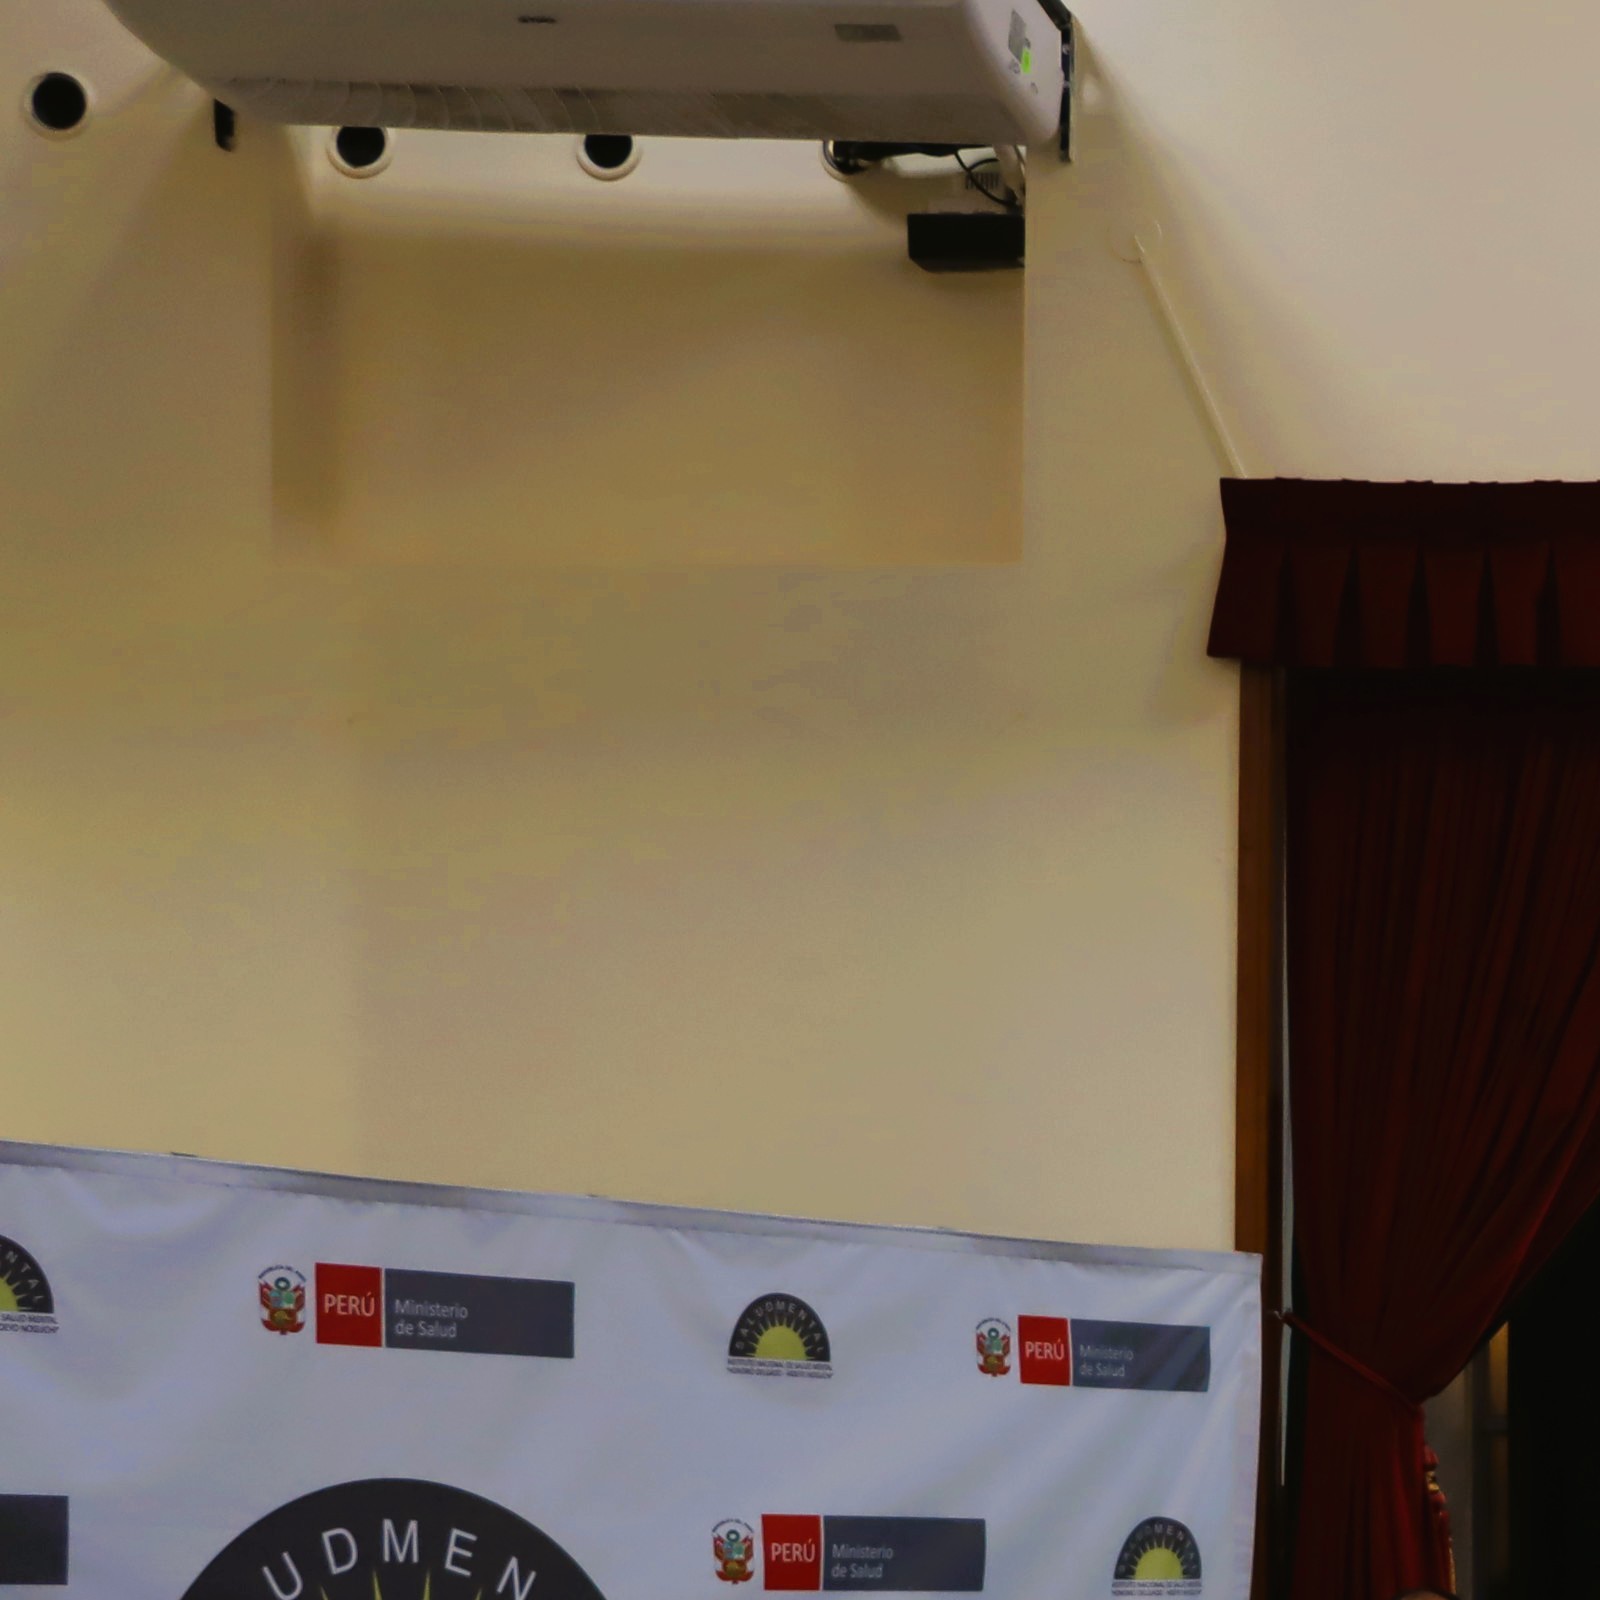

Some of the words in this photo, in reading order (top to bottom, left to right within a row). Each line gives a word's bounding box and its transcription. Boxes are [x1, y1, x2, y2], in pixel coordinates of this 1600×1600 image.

[323, 1290, 376, 1318] PERÚ
[394, 1299, 469, 1320] Ministerio
[394, 1319, 414, 1336] de
[417, 1320, 458, 1338] Salud
[1024, 1338, 1065, 1361] PERÚ
[770, 1538, 816, 1563] PERÚ
[831, 1543, 894, 1560] Ministerio
[831, 1562, 848, 1578] de
[849, 1562, 884, 1579] Salud
